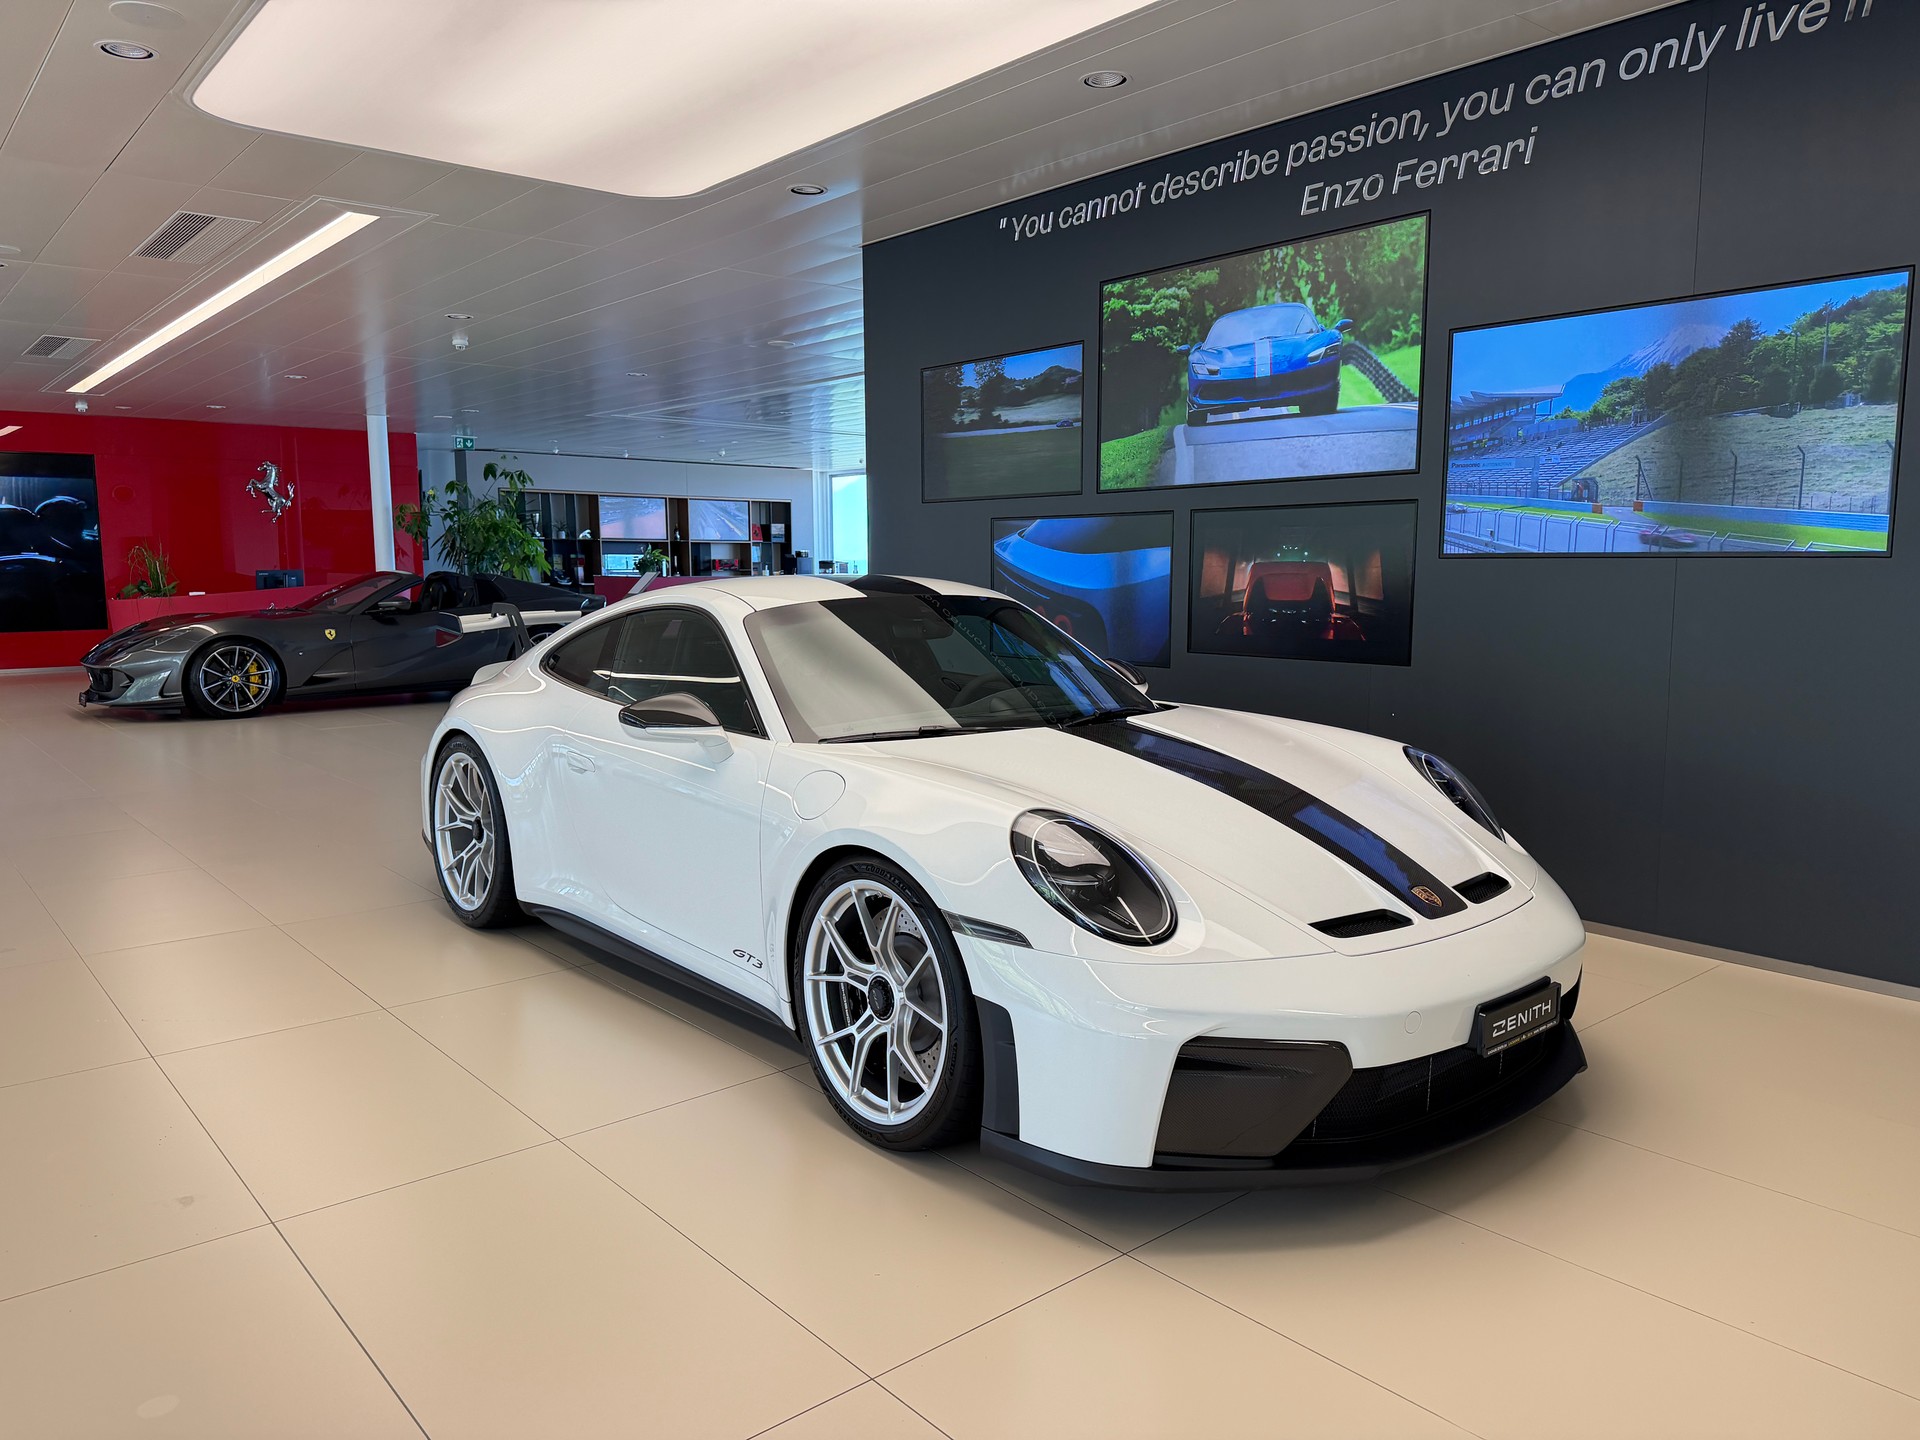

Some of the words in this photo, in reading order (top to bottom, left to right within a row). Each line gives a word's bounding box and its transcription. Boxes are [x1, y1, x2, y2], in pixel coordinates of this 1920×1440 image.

[1059, 182, 1146, 228] cannot
[1151, 150, 1279, 204] describe
[1285, 110, 1429, 176] passion,
[1436, 83, 1514, 137] you
[1526, 59, 1605, 104] can
[1619, 23, 1726, 80] only
[1736, 0, 1830, 51] live
[1301, 174, 1384, 215] Enzo
[1392, 126, 1538, 194] Ferrari
[733, 949, 763, 969] GT3
[1493, 1000, 1551, 1037] ZENITH
